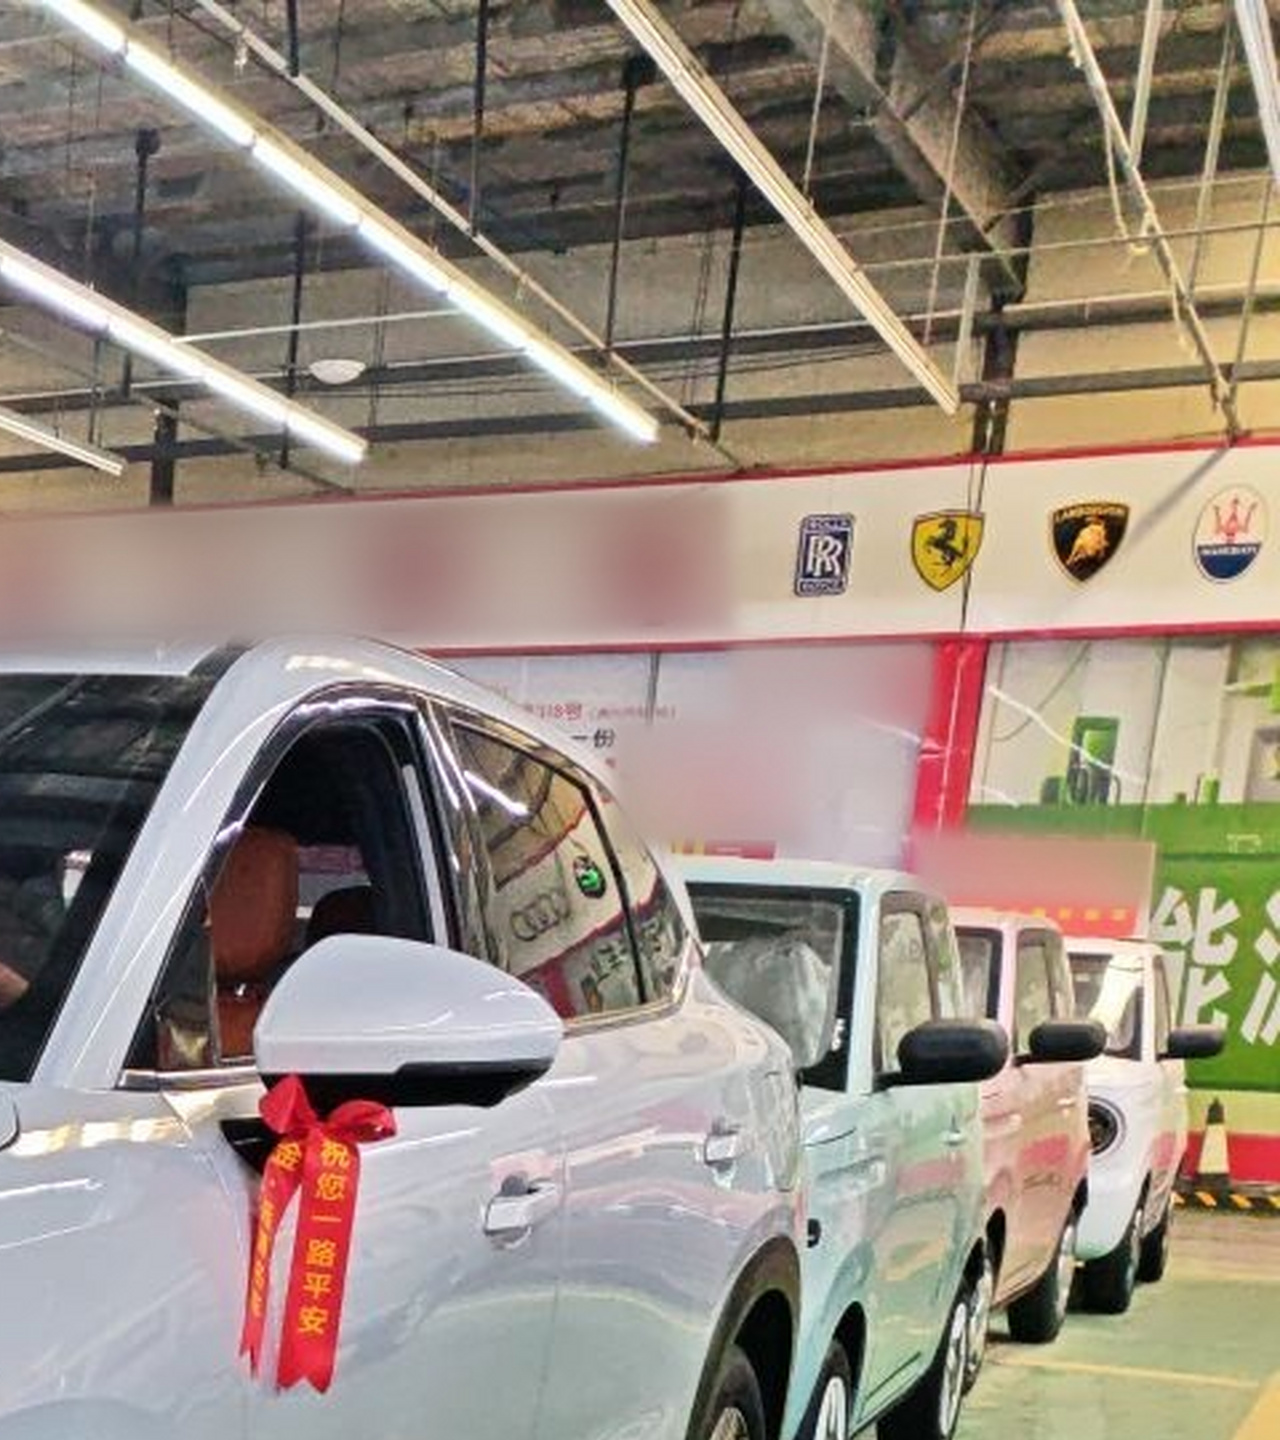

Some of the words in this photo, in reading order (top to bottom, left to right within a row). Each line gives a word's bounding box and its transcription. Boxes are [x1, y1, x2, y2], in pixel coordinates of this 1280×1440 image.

[298, 1138, 351, 1336] 祝您一路平安
